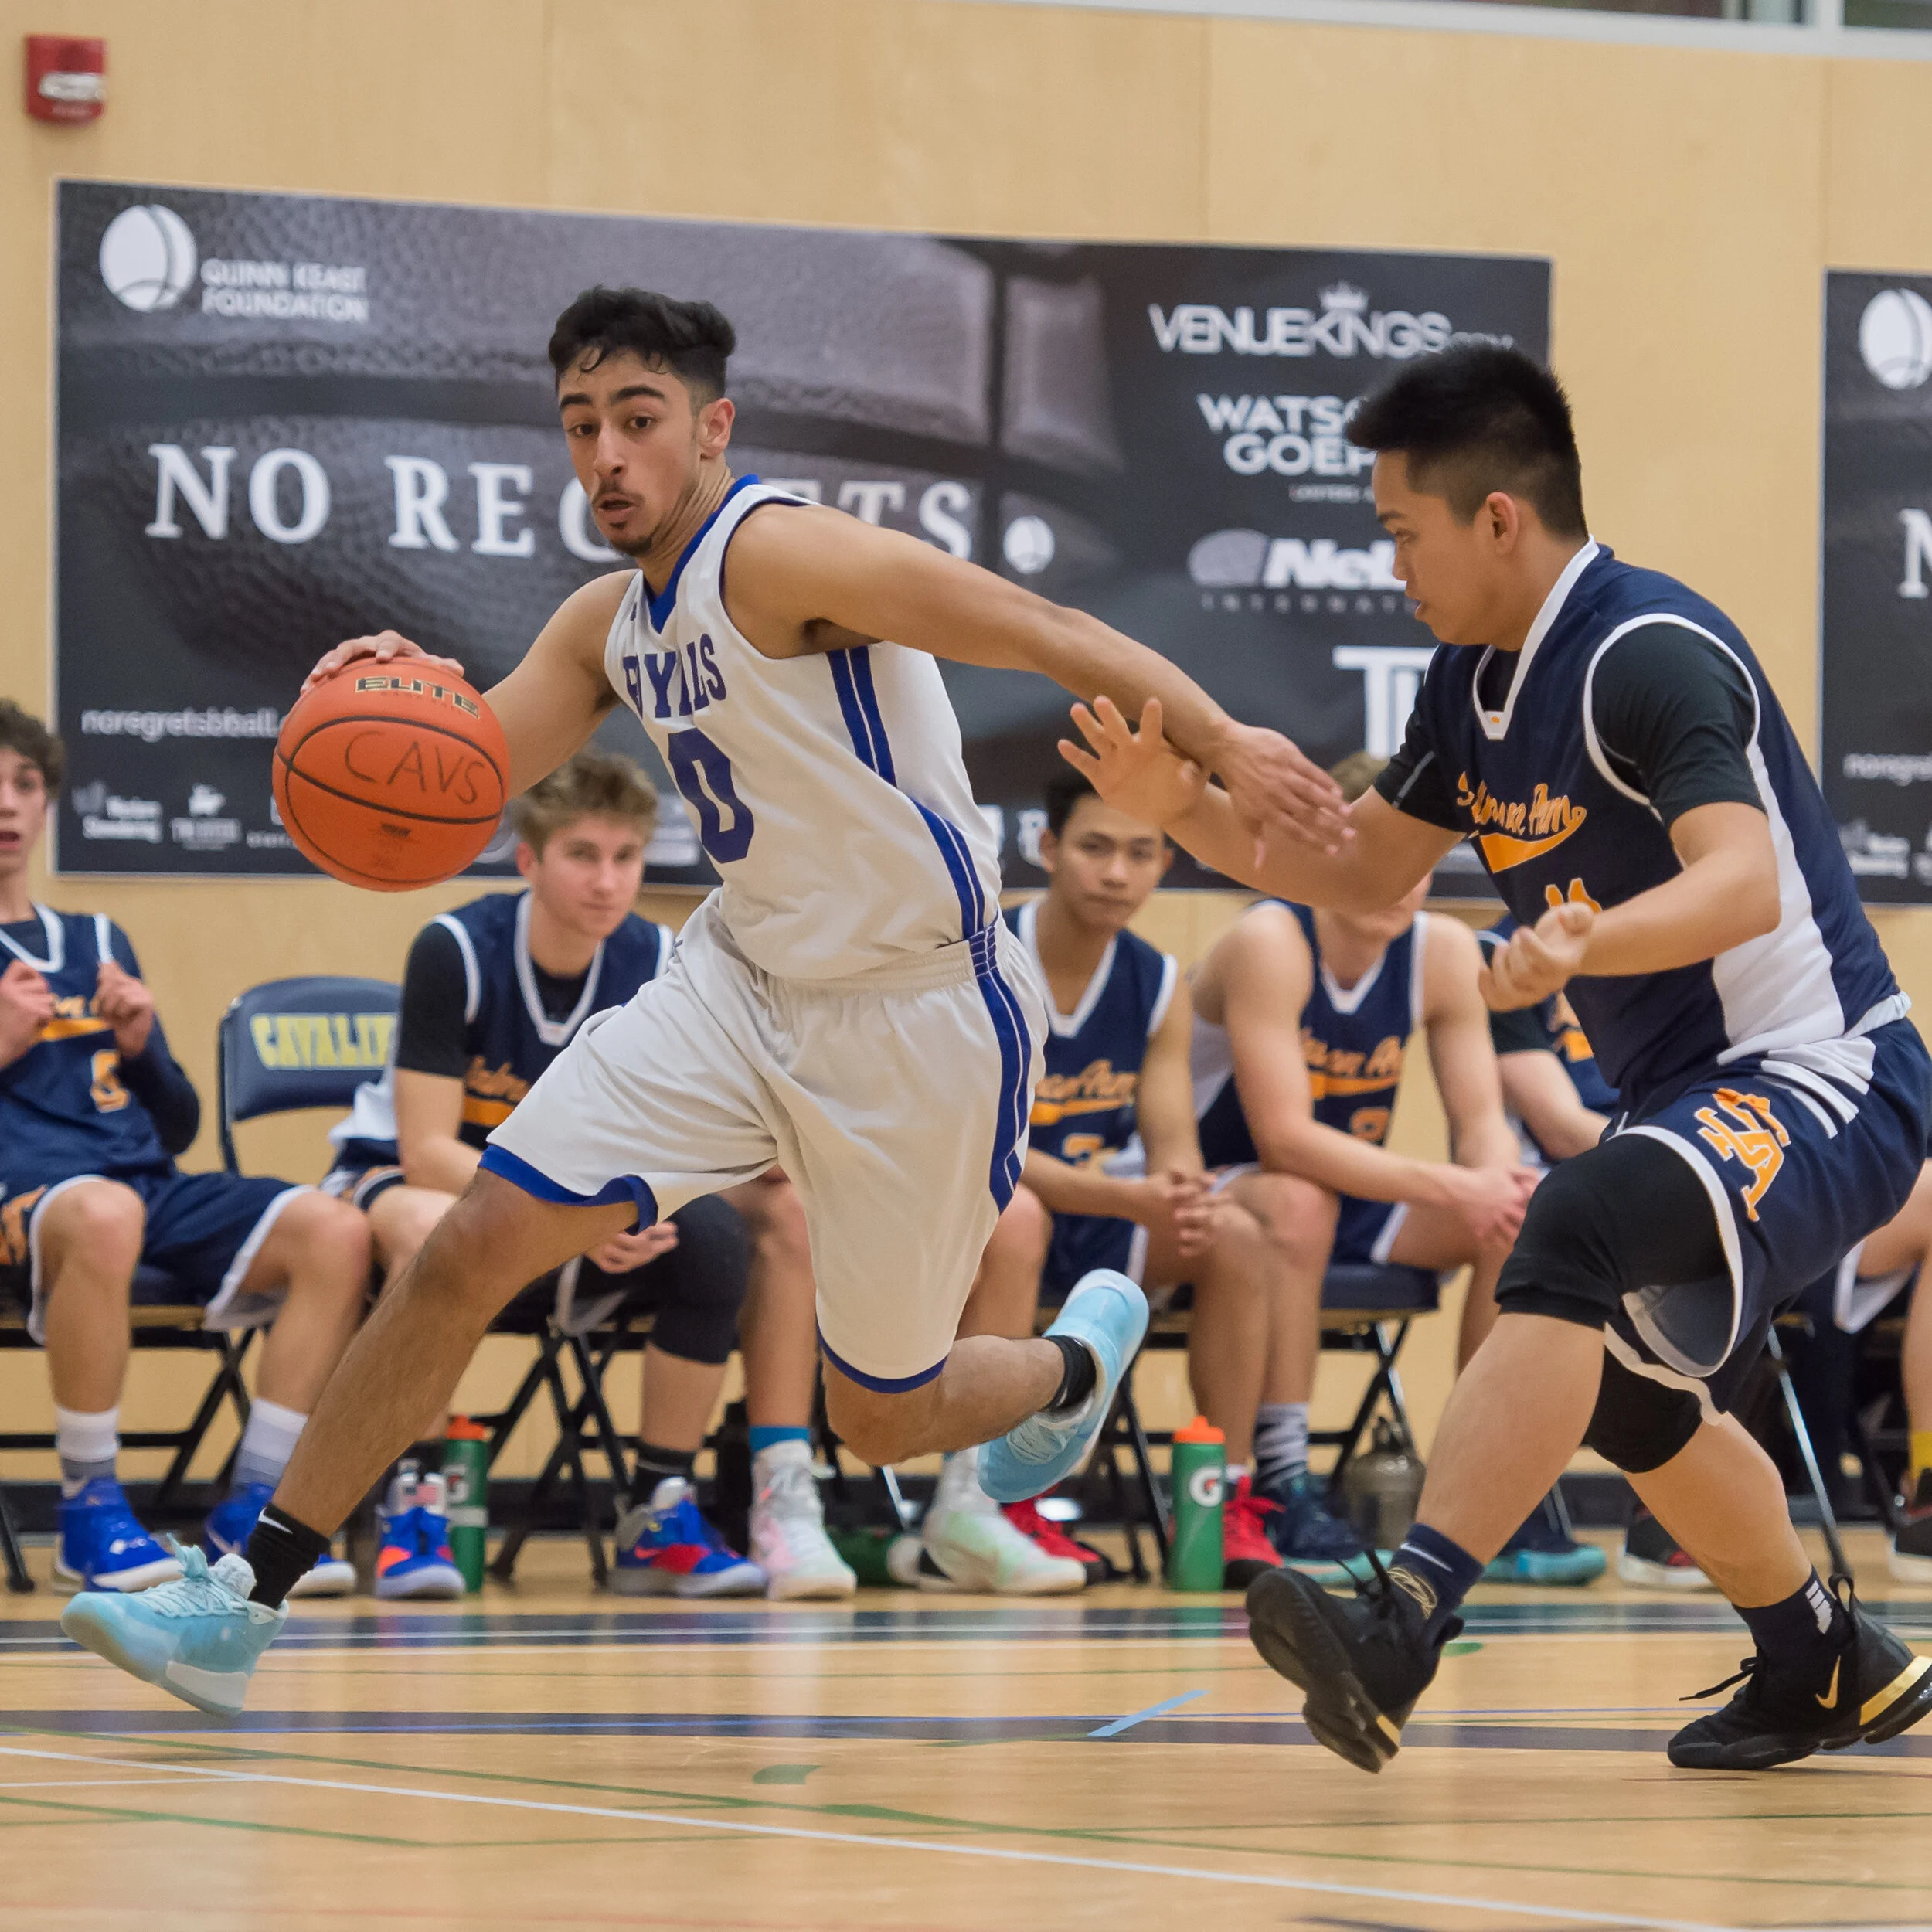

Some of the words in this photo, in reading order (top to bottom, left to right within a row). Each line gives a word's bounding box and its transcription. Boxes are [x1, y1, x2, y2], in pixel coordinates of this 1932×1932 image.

[202, 287, 370, 323] FOUNDATION
[145, 443, 331, 544] NO
[355, 675, 480, 719] ELITE
[345, 731, 485, 805] CAVS
[668, 727, 754, 864] 0
[1190, 1465, 1223, 1508] G
